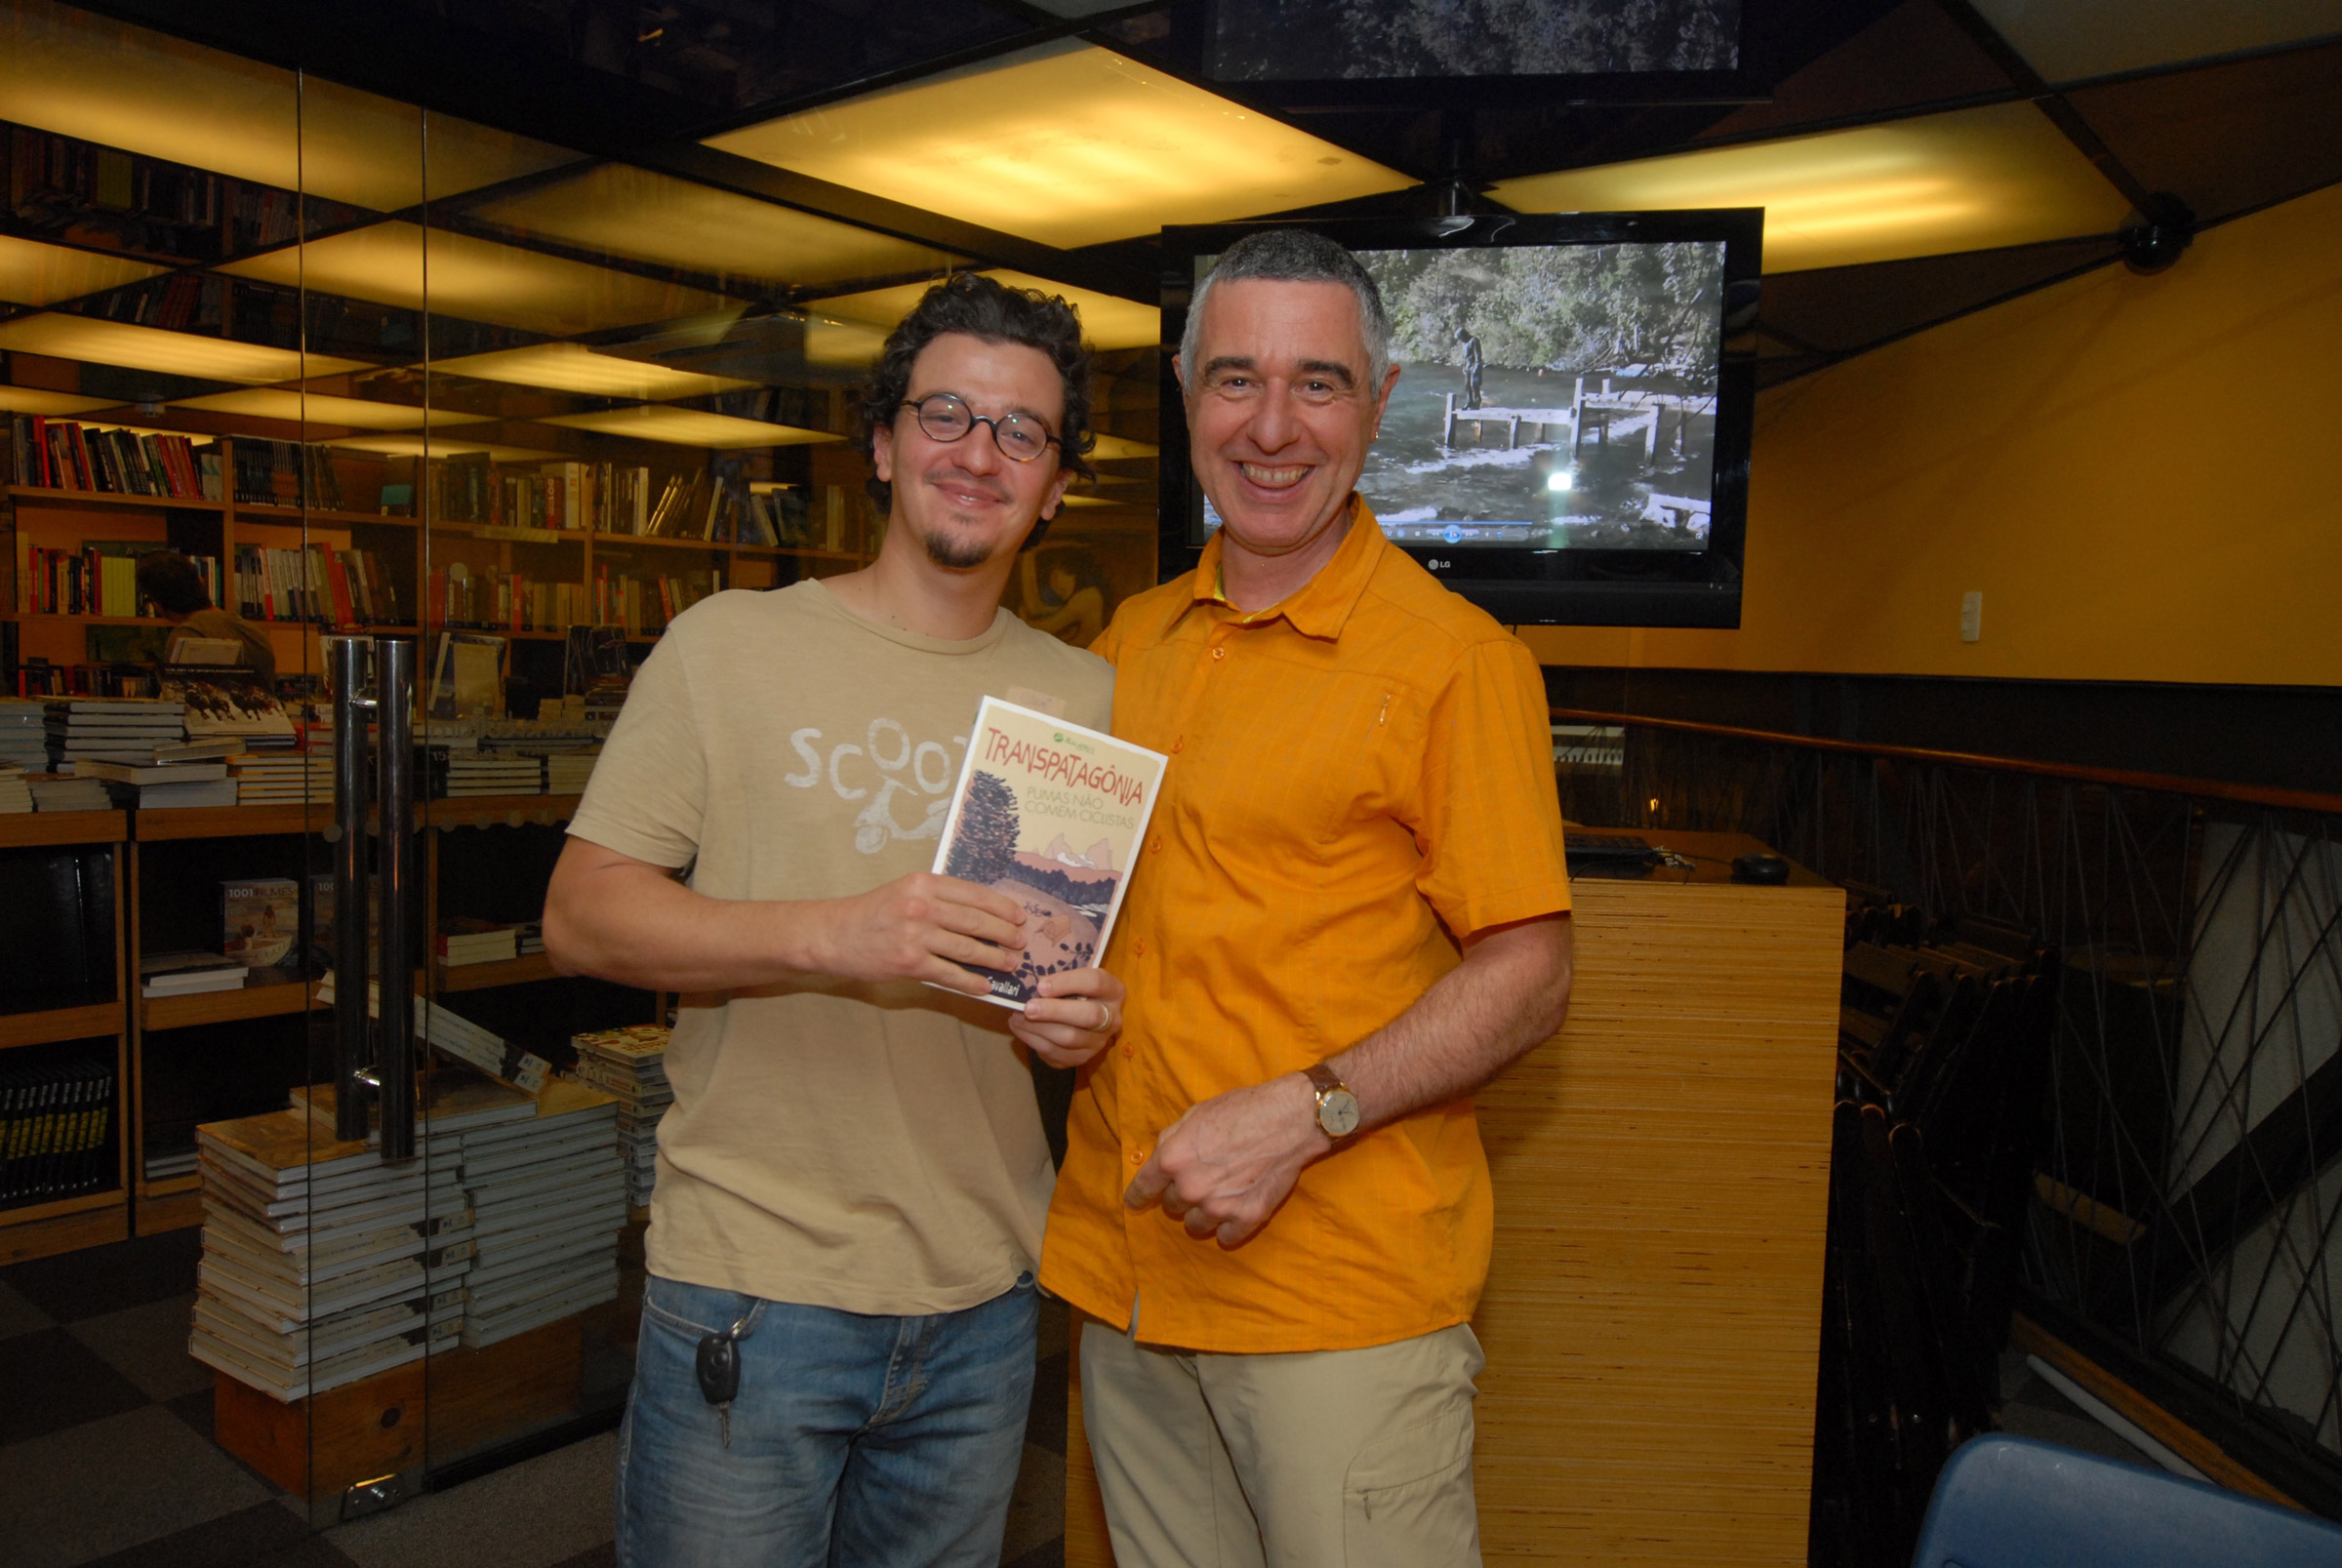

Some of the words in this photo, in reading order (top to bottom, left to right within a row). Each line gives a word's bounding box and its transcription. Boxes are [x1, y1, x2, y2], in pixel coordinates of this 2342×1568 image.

[986, 728, 1144, 806] TRANSPATAGÔNIA
[1027, 786, 1071, 805] PUMAS
[1073, 791, 1105, 810] NÃO
[1026, 800, 1078, 821] COMEM
[1079, 807, 1135, 829] CICLISTAS
[228, 888, 254, 899] 1001
[255, 887, 294, 898] FILMES
